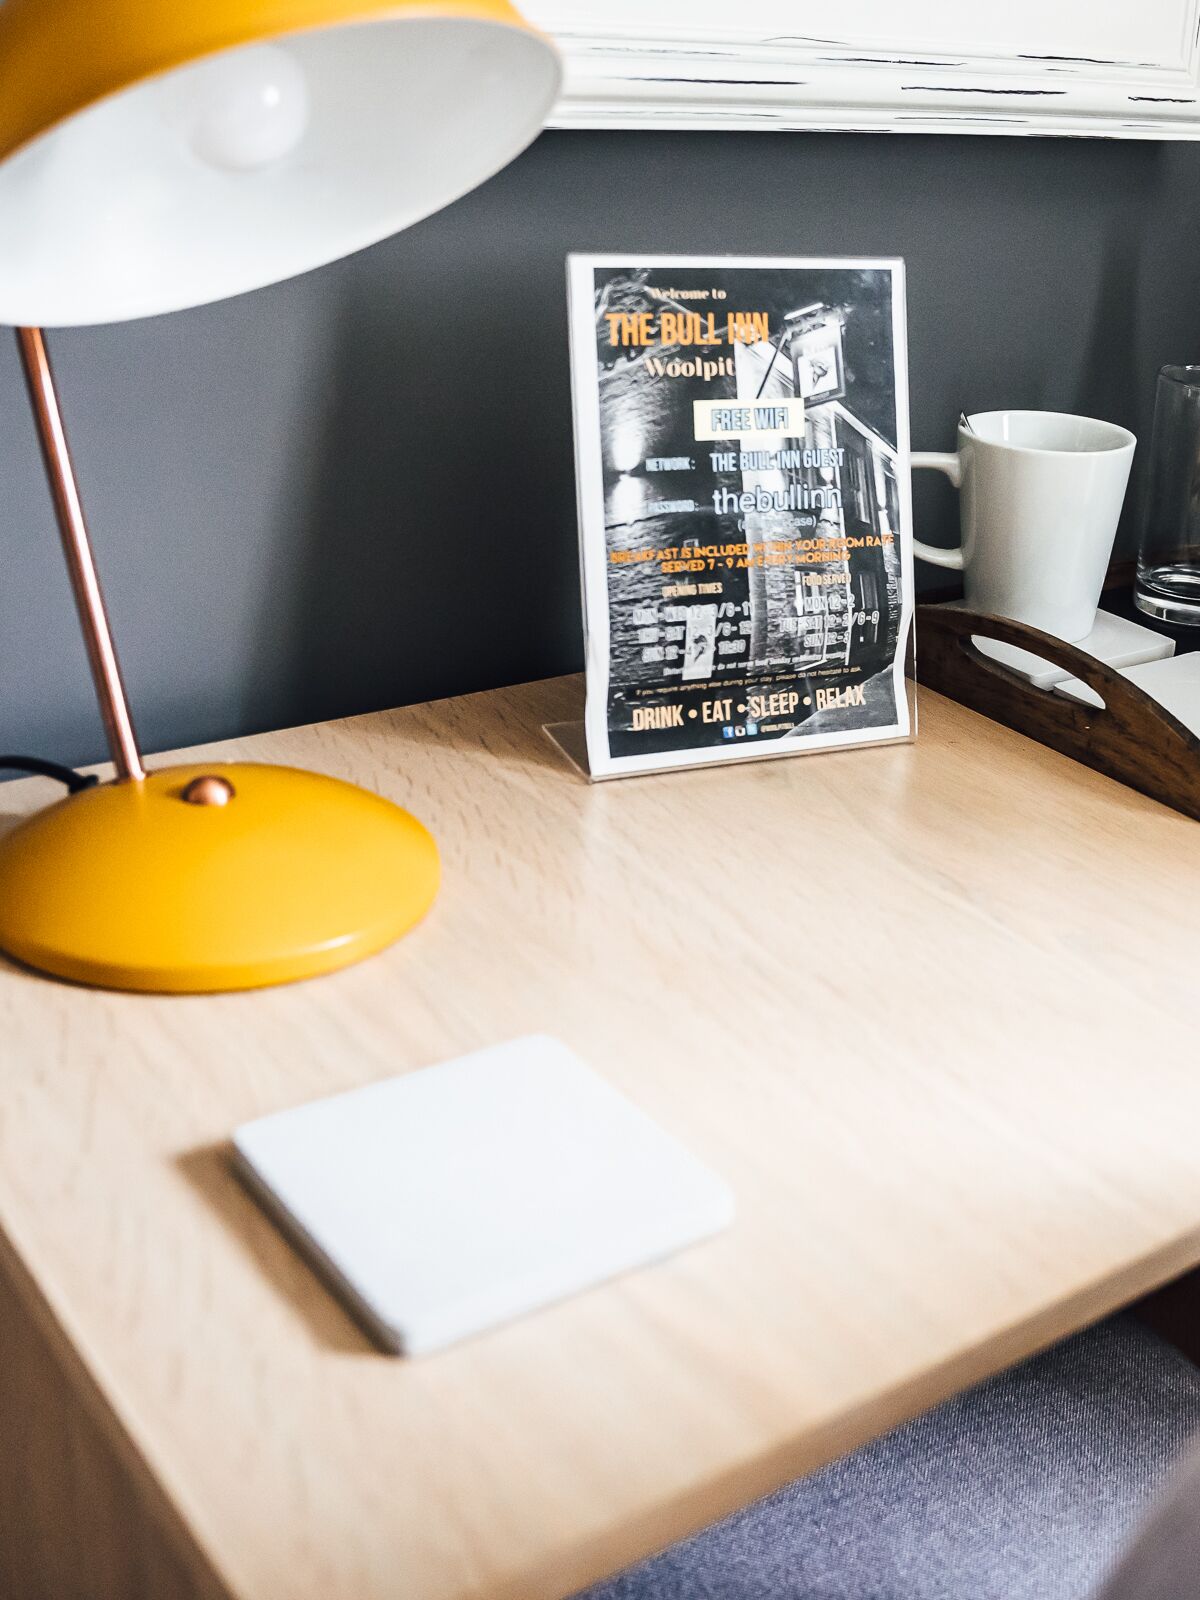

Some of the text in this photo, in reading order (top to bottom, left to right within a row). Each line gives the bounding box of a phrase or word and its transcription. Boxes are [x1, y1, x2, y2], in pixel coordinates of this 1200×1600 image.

[650, 288, 726, 300] Welcome to
[605, 312, 769, 347] THE BULL INN
[645, 356, 736, 381] Woolpit
[711, 407, 789, 431] FREE WIFI
[709, 453, 737, 473] THE
[740, 451, 774, 471] BULL
[777, 450, 800, 469] INN
[803, 448, 844, 468] GUEST
[712, 482, 843, 515] thebullinn
[610, 547, 678, 564] BREAKFAST
[681, 547, 693, 559] IS
[694, 544, 749, 558] INCLUDED
[796, 538, 826, 550] YOUR
[829, 536, 865, 549] ROOM
[866, 534, 894, 547] RATE
[661, 560, 705, 573] SERVED
[707, 559, 715, 571] 7
[726, 558, 734, 569] 9
[796, 550, 851, 563] MORNING
[632, 684, 866, 731] DRINK EAT SLEEP RELAX
